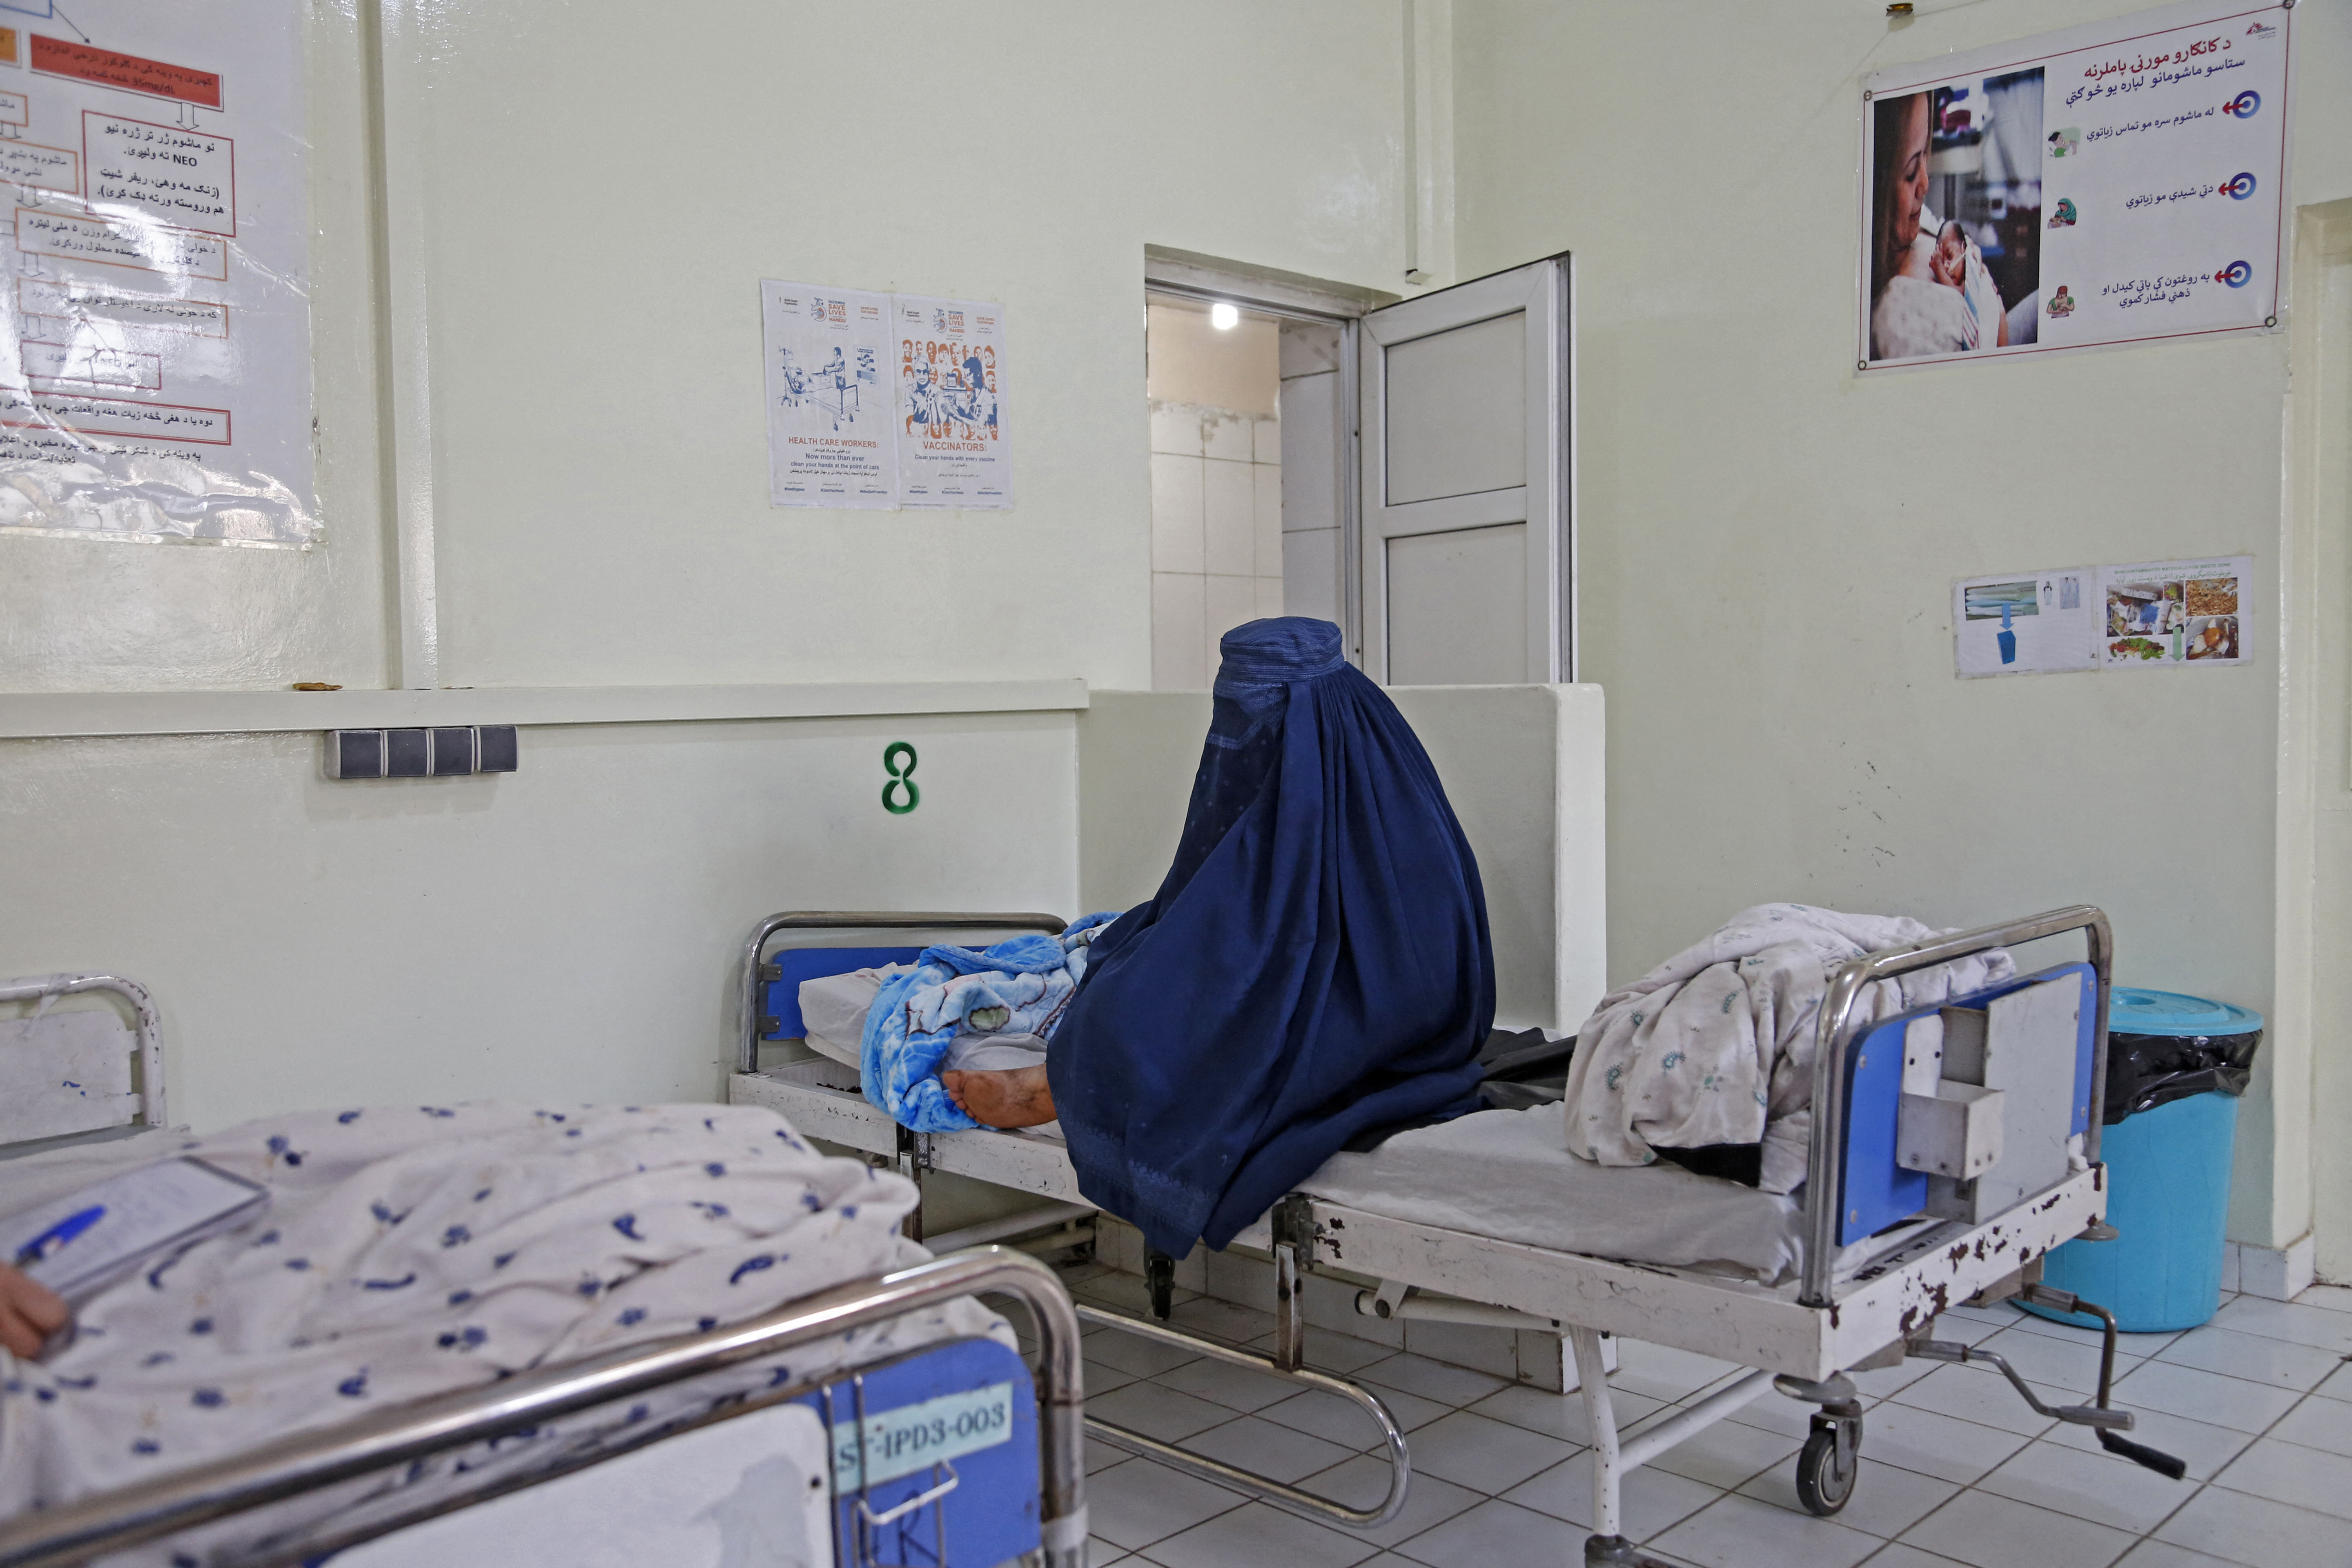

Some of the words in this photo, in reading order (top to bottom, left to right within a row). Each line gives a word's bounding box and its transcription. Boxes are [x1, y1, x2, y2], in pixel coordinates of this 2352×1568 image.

[2223, 40, 2231, 50] د
[2084, 59, 2127, 80] پاملرنه
[2204, 58, 2245, 77] ستاسو
[2151, 66, 2202, 87] ماشومانو
[2121, 76, 2144, 92] لپاره
[2205, 107, 2214, 116] له
[2155, 118, 2171, 128] سره
[2174, 111, 2202, 126] ماشوم
[2116, 121, 2139, 136] تماس
[2140, 122, 2152, 131] مو
[144, 132, 154, 141] تر
[157, 133, 170, 145] ژر
[173, 138, 202, 149] ماشوم
[205, 143, 215, 153] نو
[173, 154, 198, 167] NEO
[180, 182, 191, 190] مه
[149, 193, 172, 207] ورته
[2154, 195, 2166, 204] مو
[174, 198, 211, 214] وروسته
[214, 206, 225, 216] هم
[2165, 274, 2198, 287] روغتون
[2201, 273, 2210, 283] په
[2102, 285, 2109, 296] او
[191, 416, 197, 425] یا
[789, 437, 817, 445] HEALTH
[841, 440, 879, 448] WORKERS:
[923, 441, 987, 452] VACCINATORS:
[882, 742, 920, 815] 8
[837, 1401, 1006, 1472] S-IPD3-003
